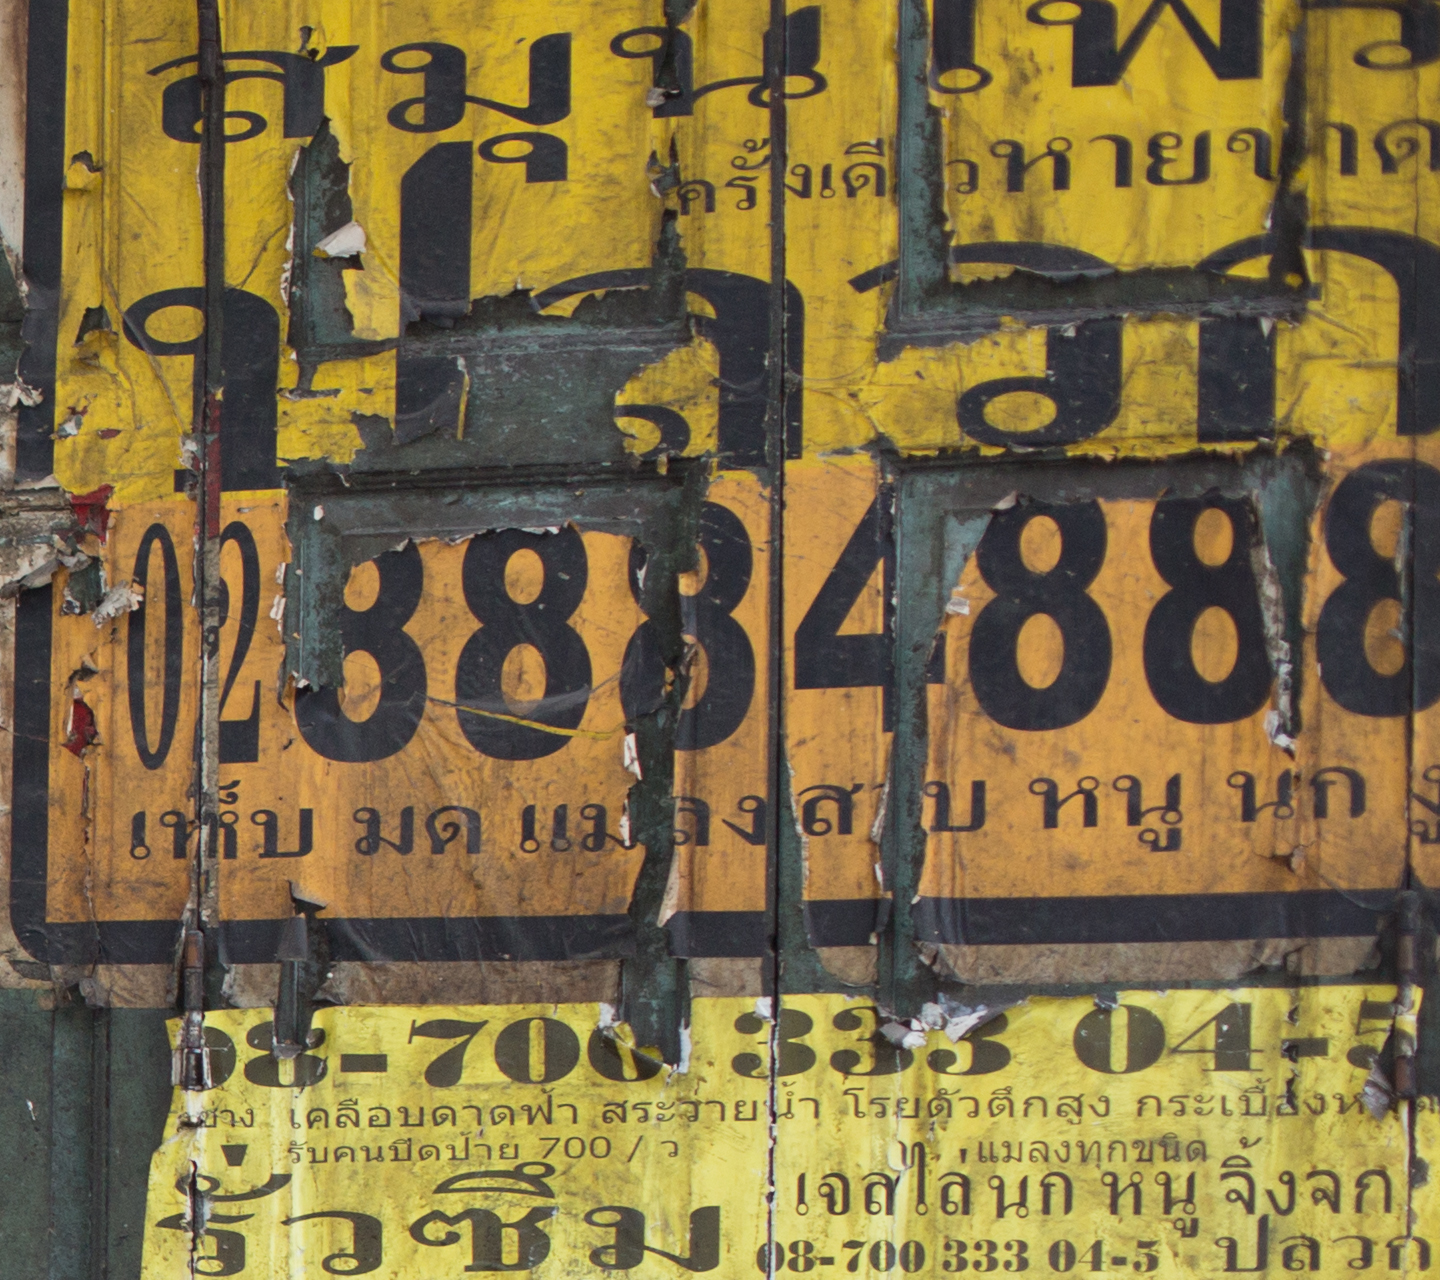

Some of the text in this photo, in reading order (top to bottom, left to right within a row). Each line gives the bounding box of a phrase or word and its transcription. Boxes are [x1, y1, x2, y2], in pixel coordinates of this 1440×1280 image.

[355, 805, 481, 857] มด
[1030, 770, 1183, 854] หนู
[1226, 764, 1366, 822] นก
[290, 1087, 578, 1129] เคลือบดาดฟ้า
[539, 1136, 612, 1160] 700
[1102, 1171, 1199, 1239] หนู
[1221, 1136, 1392, 1216] จิ้งจก
[757, 1239, 1160, 1274] 08-700 333 04-5
[1216, 1214, 1431, 1273] ปลวก
